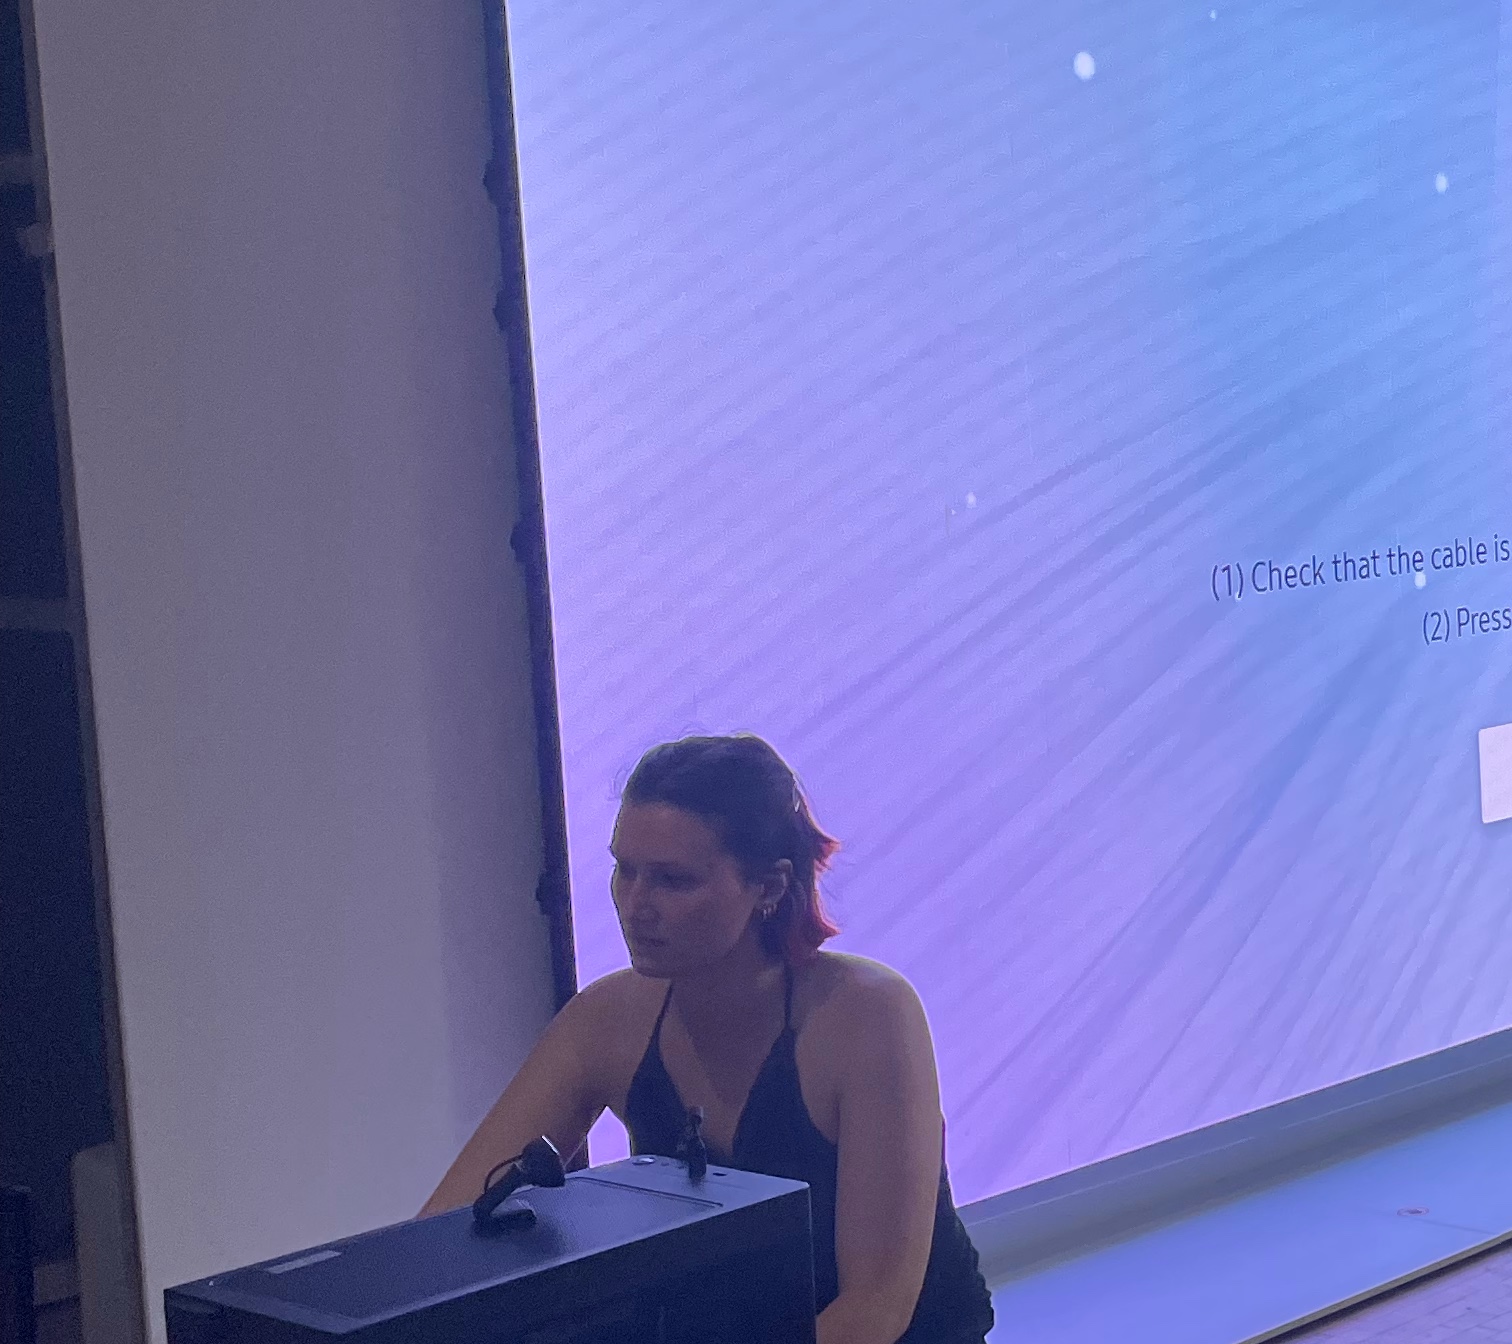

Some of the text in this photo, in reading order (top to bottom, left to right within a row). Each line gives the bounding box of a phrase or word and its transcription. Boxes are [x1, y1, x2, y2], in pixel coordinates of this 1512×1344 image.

[1211, 562, 1244, 602] (1)
[1251, 554, 1326, 593] Check
[1331, 549, 1381, 583] that
[1386, 544, 1424, 576] the
[1430, 537, 1488, 570] cable
[1493, 533, 1511, 562] is
[1423, 609, 1451, 646] (2)
[1457, 607, 1512, 637] Press
